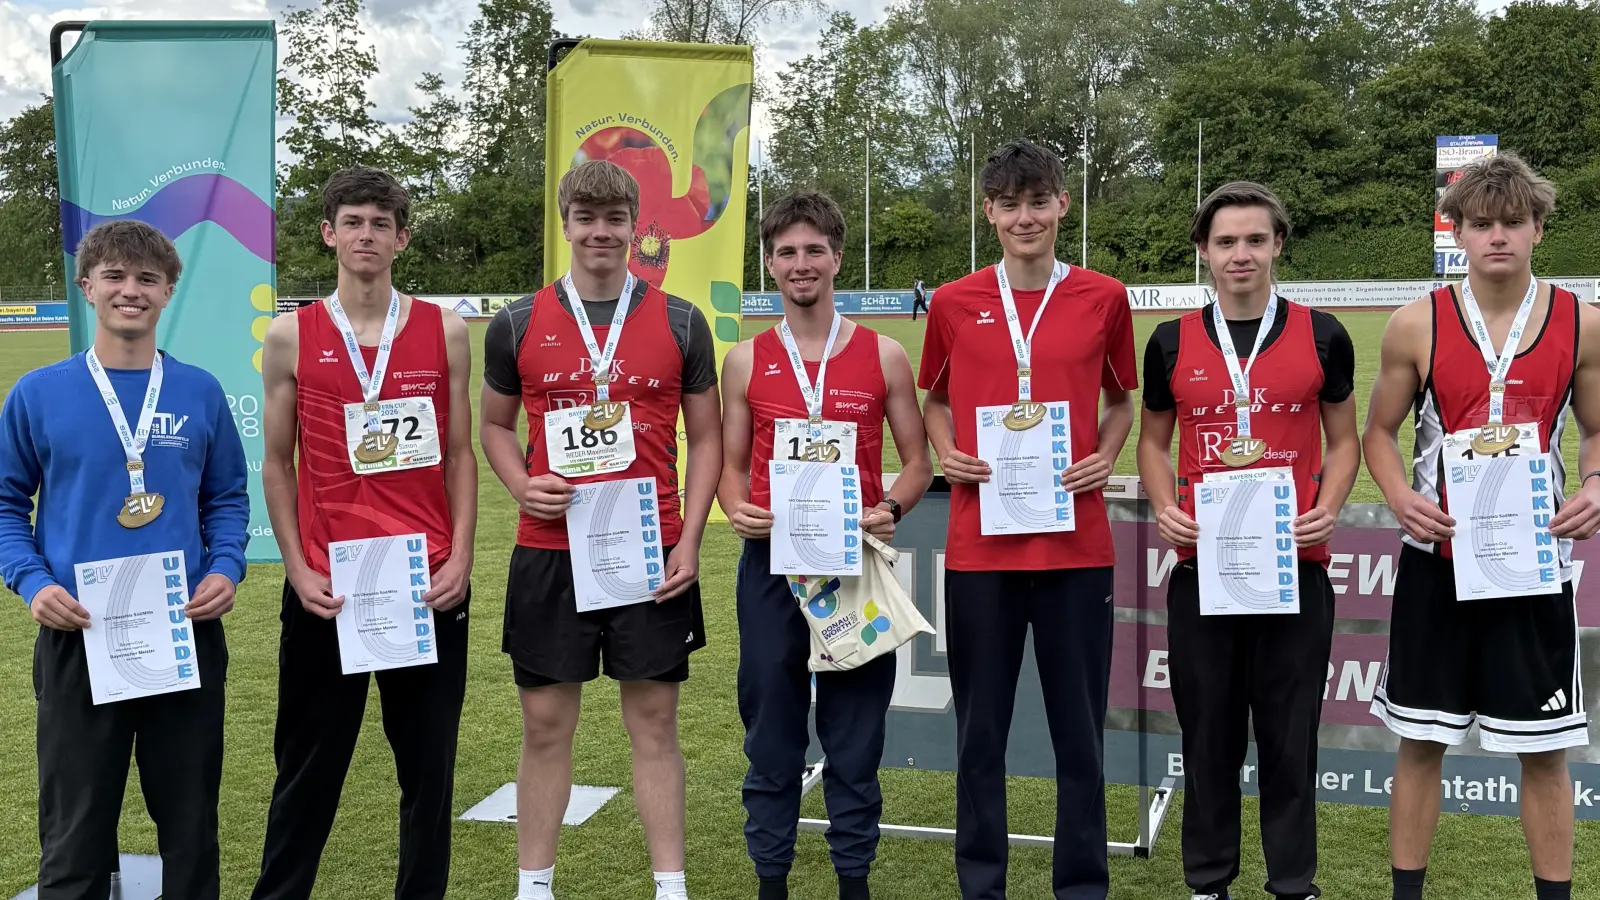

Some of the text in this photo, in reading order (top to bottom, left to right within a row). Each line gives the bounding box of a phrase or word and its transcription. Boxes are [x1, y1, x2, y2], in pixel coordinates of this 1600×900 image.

[575, 112, 679, 163] Natur. Verbunden.
[1438, 148, 1484, 156] ISO-Brand
[112, 157, 226, 211] Natur. Verbunden.
[742, 296, 773, 306] CHäTZL
[1166, 296, 1196, 306] PLAN
[579, 358, 625, 375] DK
[1222, 388, 1268, 404] DK
[1192, 404, 1302, 416] WEDEN
[561, 425, 618, 451] 186
[632, 421, 651, 432] sign
[1050, 407, 1069, 521] URKUNDE
[1264, 447, 1298, 462] design
[841, 467, 858, 564] URKUNDE
[1529, 459, 1555, 582] URKUNDE
[637, 483, 660, 591] URKUNDE
[1274, 486, 1294, 602] URKUNDE
[407, 539, 432, 654] URKUNDE
[163, 557, 193, 678] URKUNDE
[821, 615, 849, 636] DONAU
[824, 621, 852, 640] WORTH
